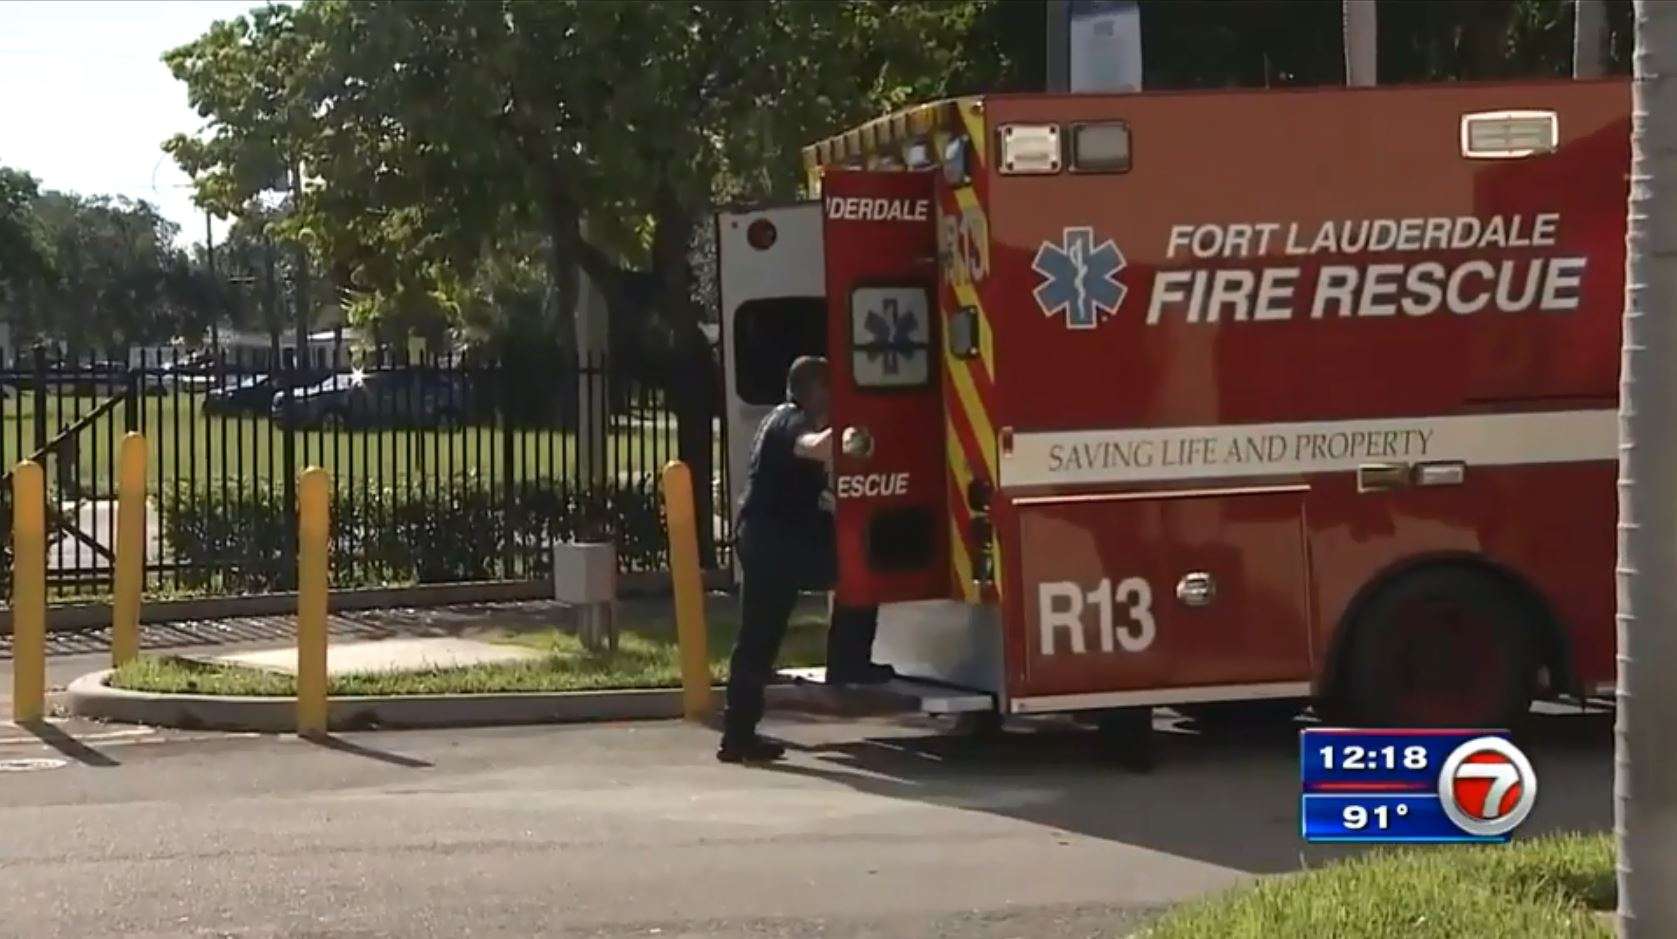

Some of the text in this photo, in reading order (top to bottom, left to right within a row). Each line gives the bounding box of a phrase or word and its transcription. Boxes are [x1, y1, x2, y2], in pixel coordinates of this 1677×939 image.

[826, 196, 929, 221] DERDALE
[1166, 213, 1560, 258] FORT LAUDERDALE
[1145, 256, 1588, 325] FIRE RESCUE
[1048, 428, 1434, 472] SAVING LIFE AND PROPERTY
[1038, 577, 1156, 655] R13
